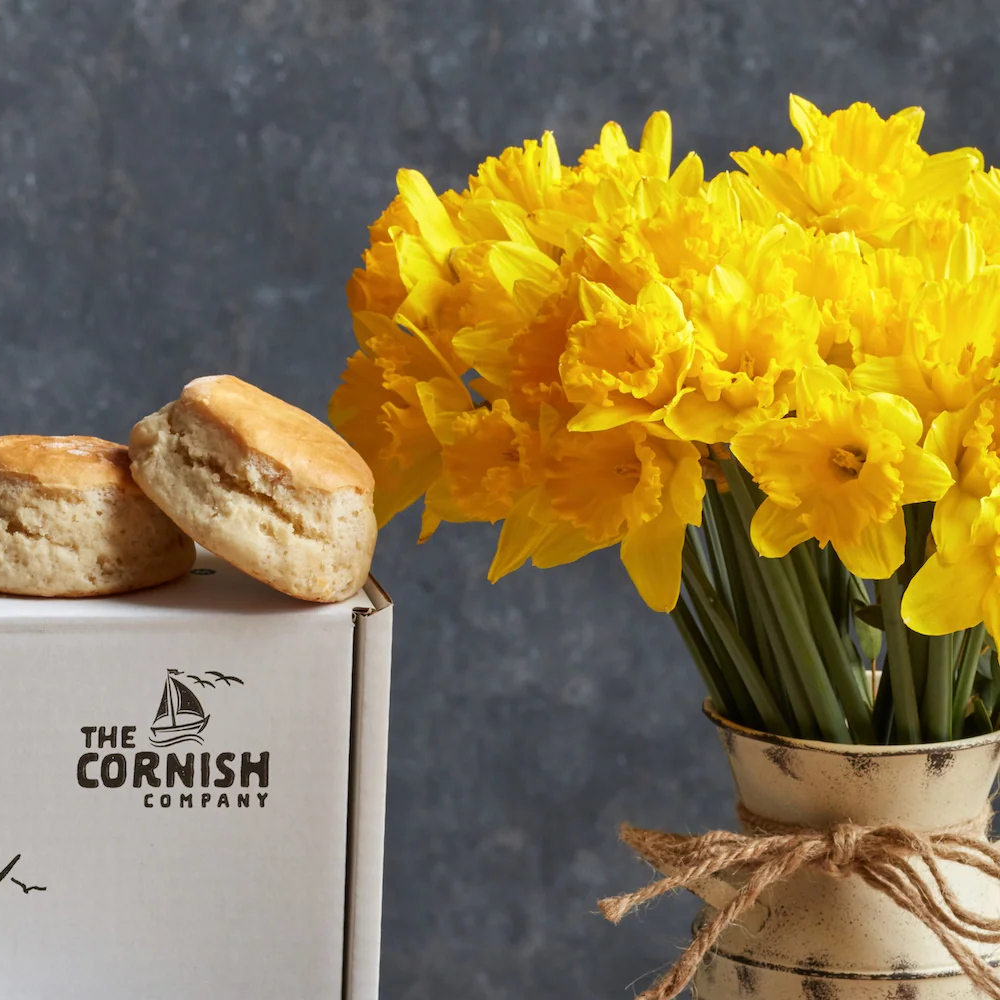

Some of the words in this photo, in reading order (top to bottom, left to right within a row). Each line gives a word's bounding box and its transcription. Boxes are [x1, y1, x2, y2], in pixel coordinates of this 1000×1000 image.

[80, 725, 136, 748] THE
[77, 751, 270, 788] CORNISH
[144, 793, 268, 808] COMPANY
